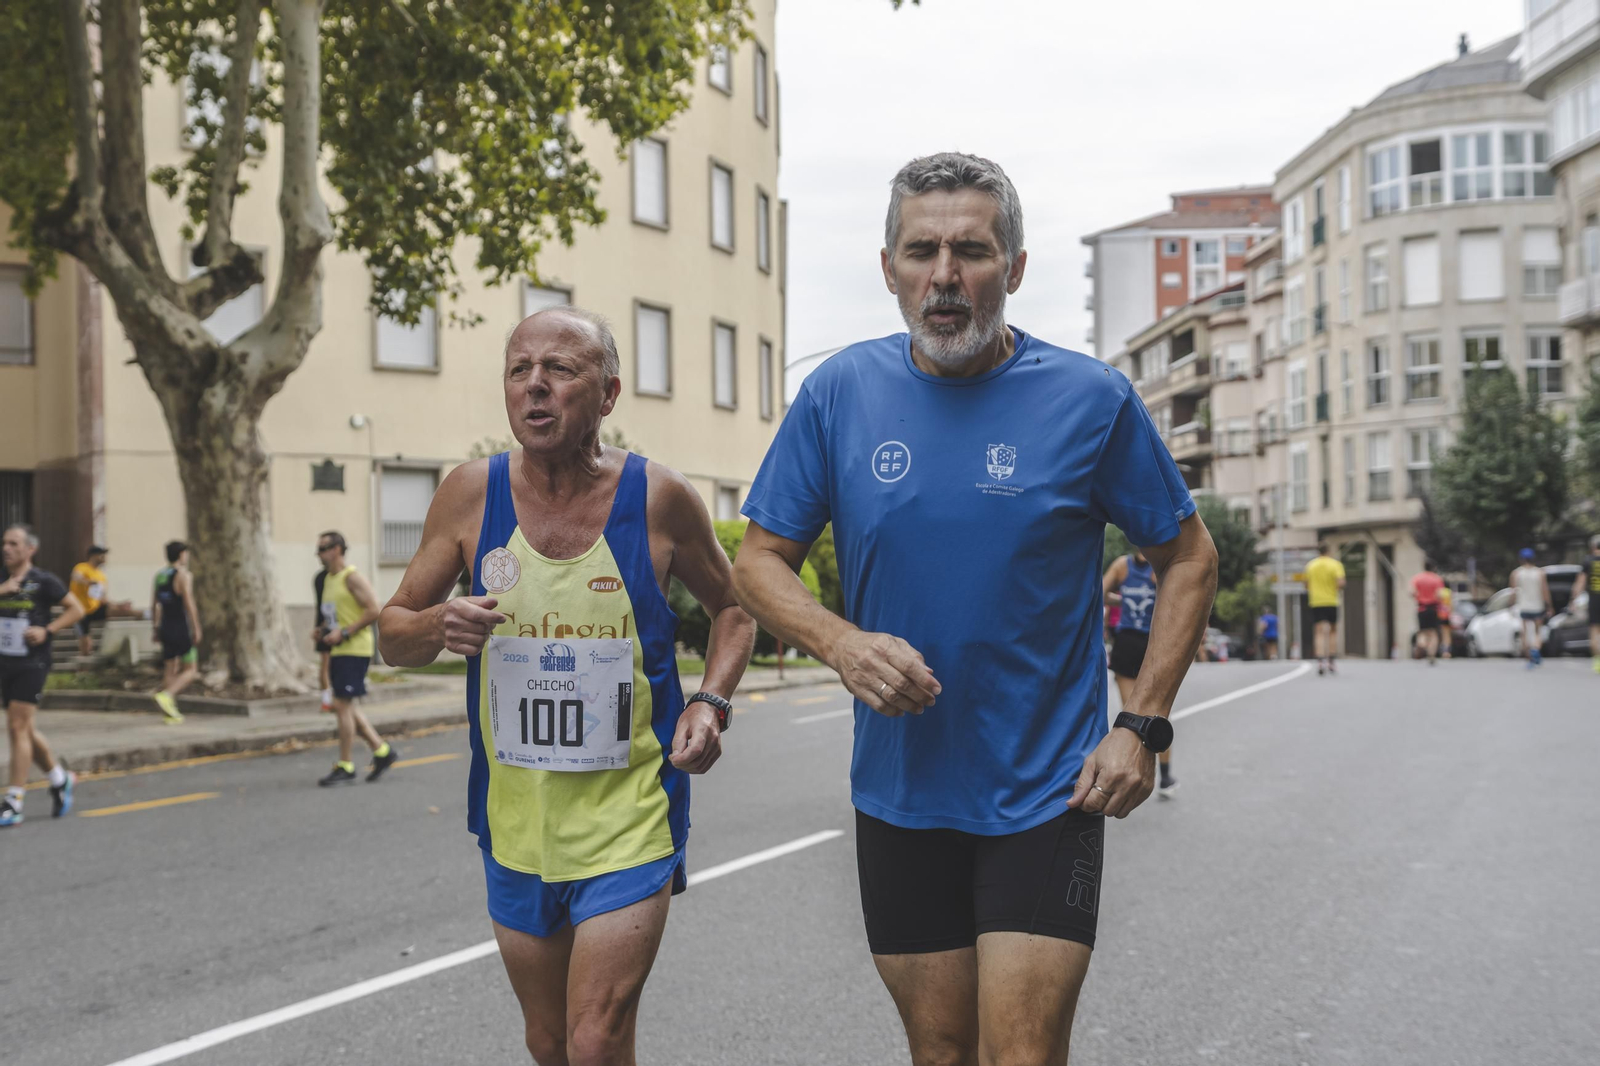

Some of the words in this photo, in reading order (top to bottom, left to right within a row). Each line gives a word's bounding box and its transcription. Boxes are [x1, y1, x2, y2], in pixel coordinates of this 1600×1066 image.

[527, 679, 575, 692] CHICHO
[518, 697, 584, 747] 100
[1066, 829, 1099, 913] FILA
